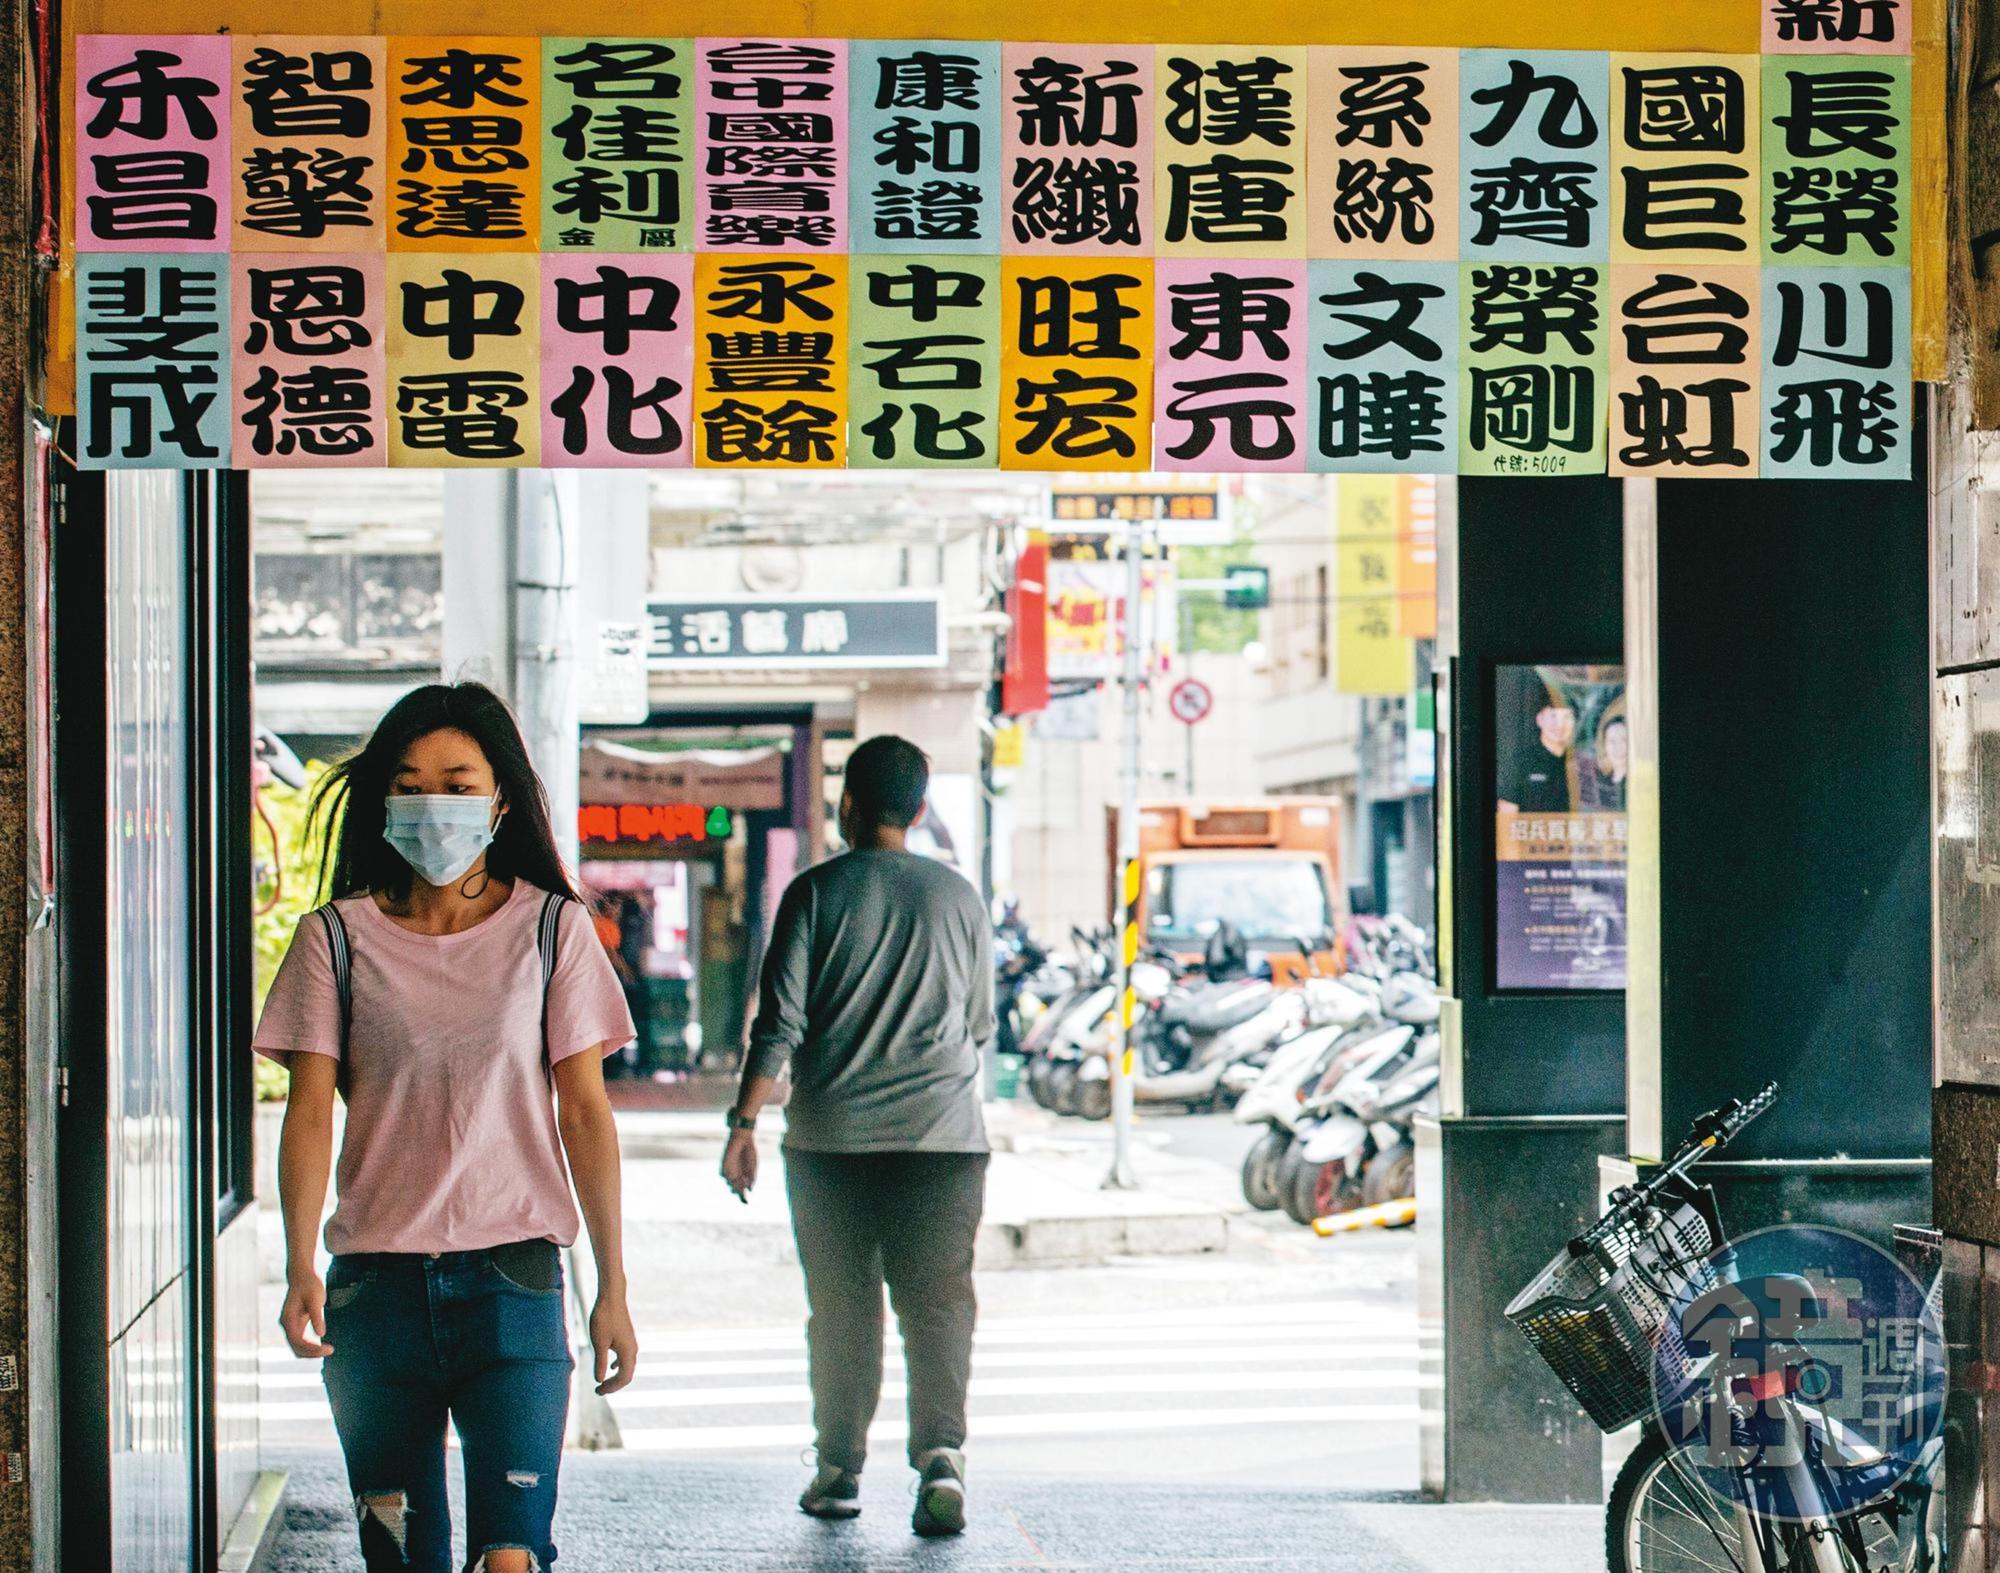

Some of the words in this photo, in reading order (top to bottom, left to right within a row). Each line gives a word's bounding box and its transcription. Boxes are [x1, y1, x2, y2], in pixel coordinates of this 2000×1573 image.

[86, 50, 219, 240] 禾昌
[241, 48, 373, 238] 智擎
[397, 49, 529, 238] 來思達
[552, 43, 683, 224] 名佳利
[706, 43, 836, 246] 台中國際育樂
[872, 51, 983, 239] 康和證
[1013, 57, 1142, 245] 新纖
[1165, 57, 1295, 242] 漢唐
[1334, 62, 1434, 244] 系統
[1470, 60, 1598, 247] 九齊
[1621, 66, 1749, 251] 國巨
[1771, 71, 1900, 256] 長榮
[559, 228, 675, 247] 金屬
[86, 268, 219, 458] 斐成
[242, 266, 373, 455] 恩德
[396, 270, 528, 458] 中電
[551, 266, 682, 455] 中化
[702, 262, 837, 462] 永豐餘
[861, 265, 985, 459] 中石化
[1015, 274, 1141, 457] 旺宏
[1166, 273, 1295, 460] 東元
[1318, 272, 1446, 460] 文曄
[1469, 266, 1599, 452] 榮剛
[1619, 274, 1750, 466] 台虹
[1770, 282, 1898, 466] 川飛
